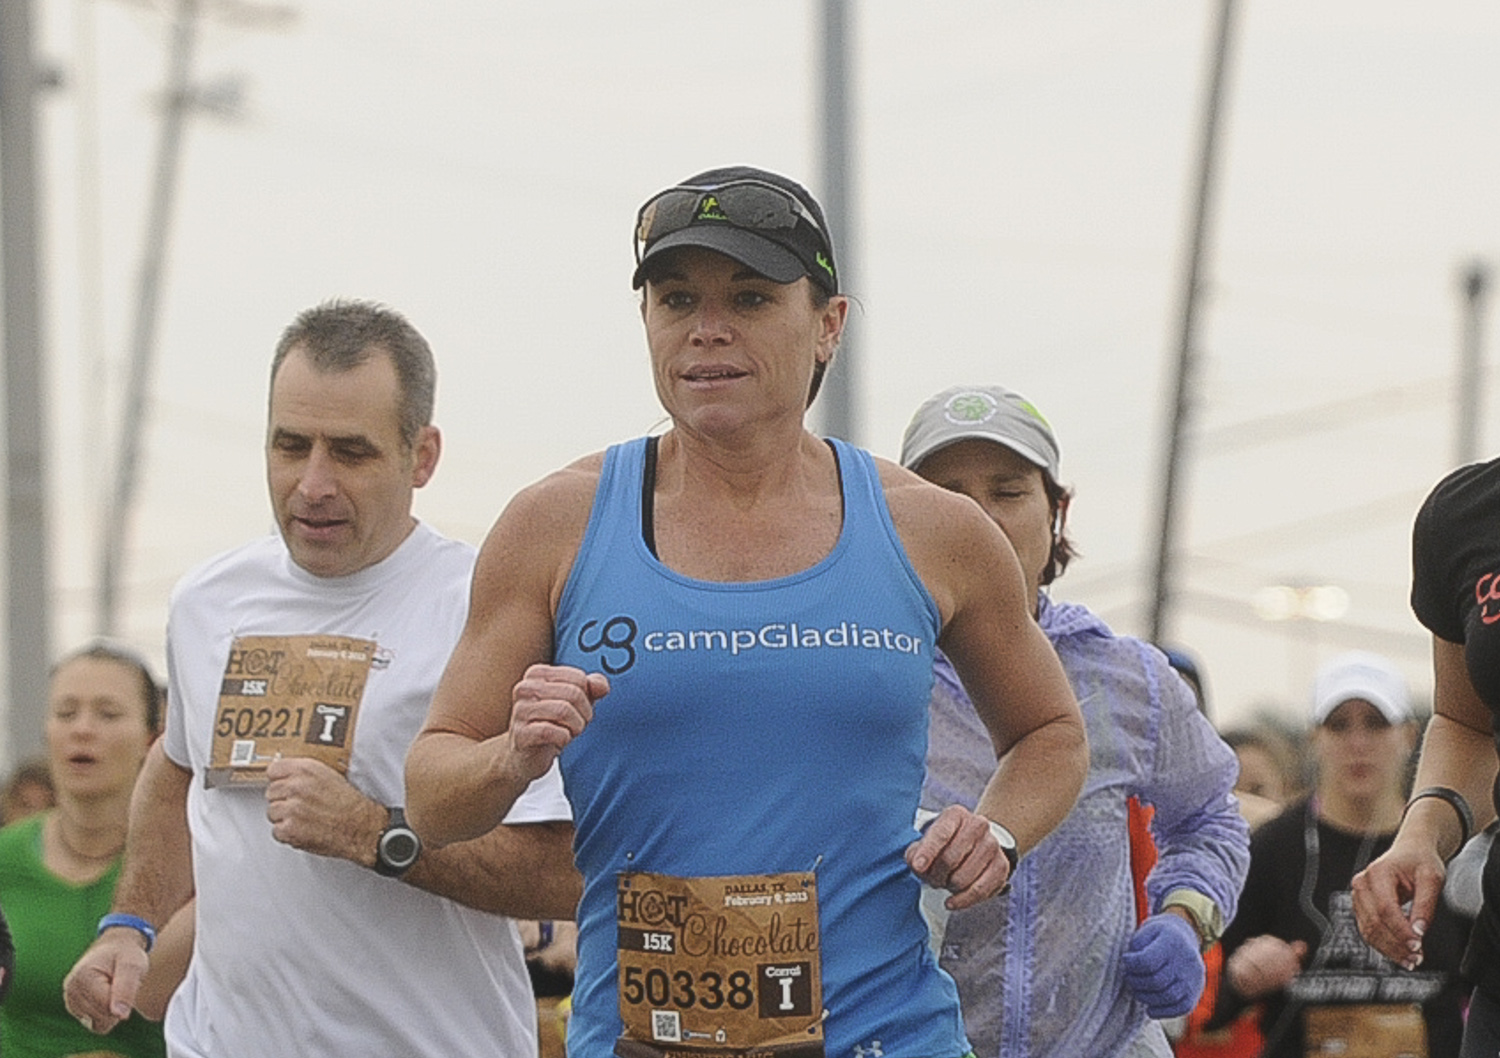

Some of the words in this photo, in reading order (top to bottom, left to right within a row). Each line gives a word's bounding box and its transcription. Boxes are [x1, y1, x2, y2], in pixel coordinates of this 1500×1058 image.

[644, 622, 921, 655] campGladiator
[225, 648, 285, 675] HOT
[241, 680, 266, 695] 15K
[272, 662, 362, 700] Chocolate
[217, 708, 305, 738] 50221
[319, 715, 337, 742] I
[617, 889, 688, 928] HOT
[724, 894, 773, 907] February
[643, 932, 673, 951] 15K
[680, 911, 820, 957] Chocolate
[765, 965, 802, 978] Corral
[624, 966, 754, 1010] 50338
[779, 977, 795, 1010] I
